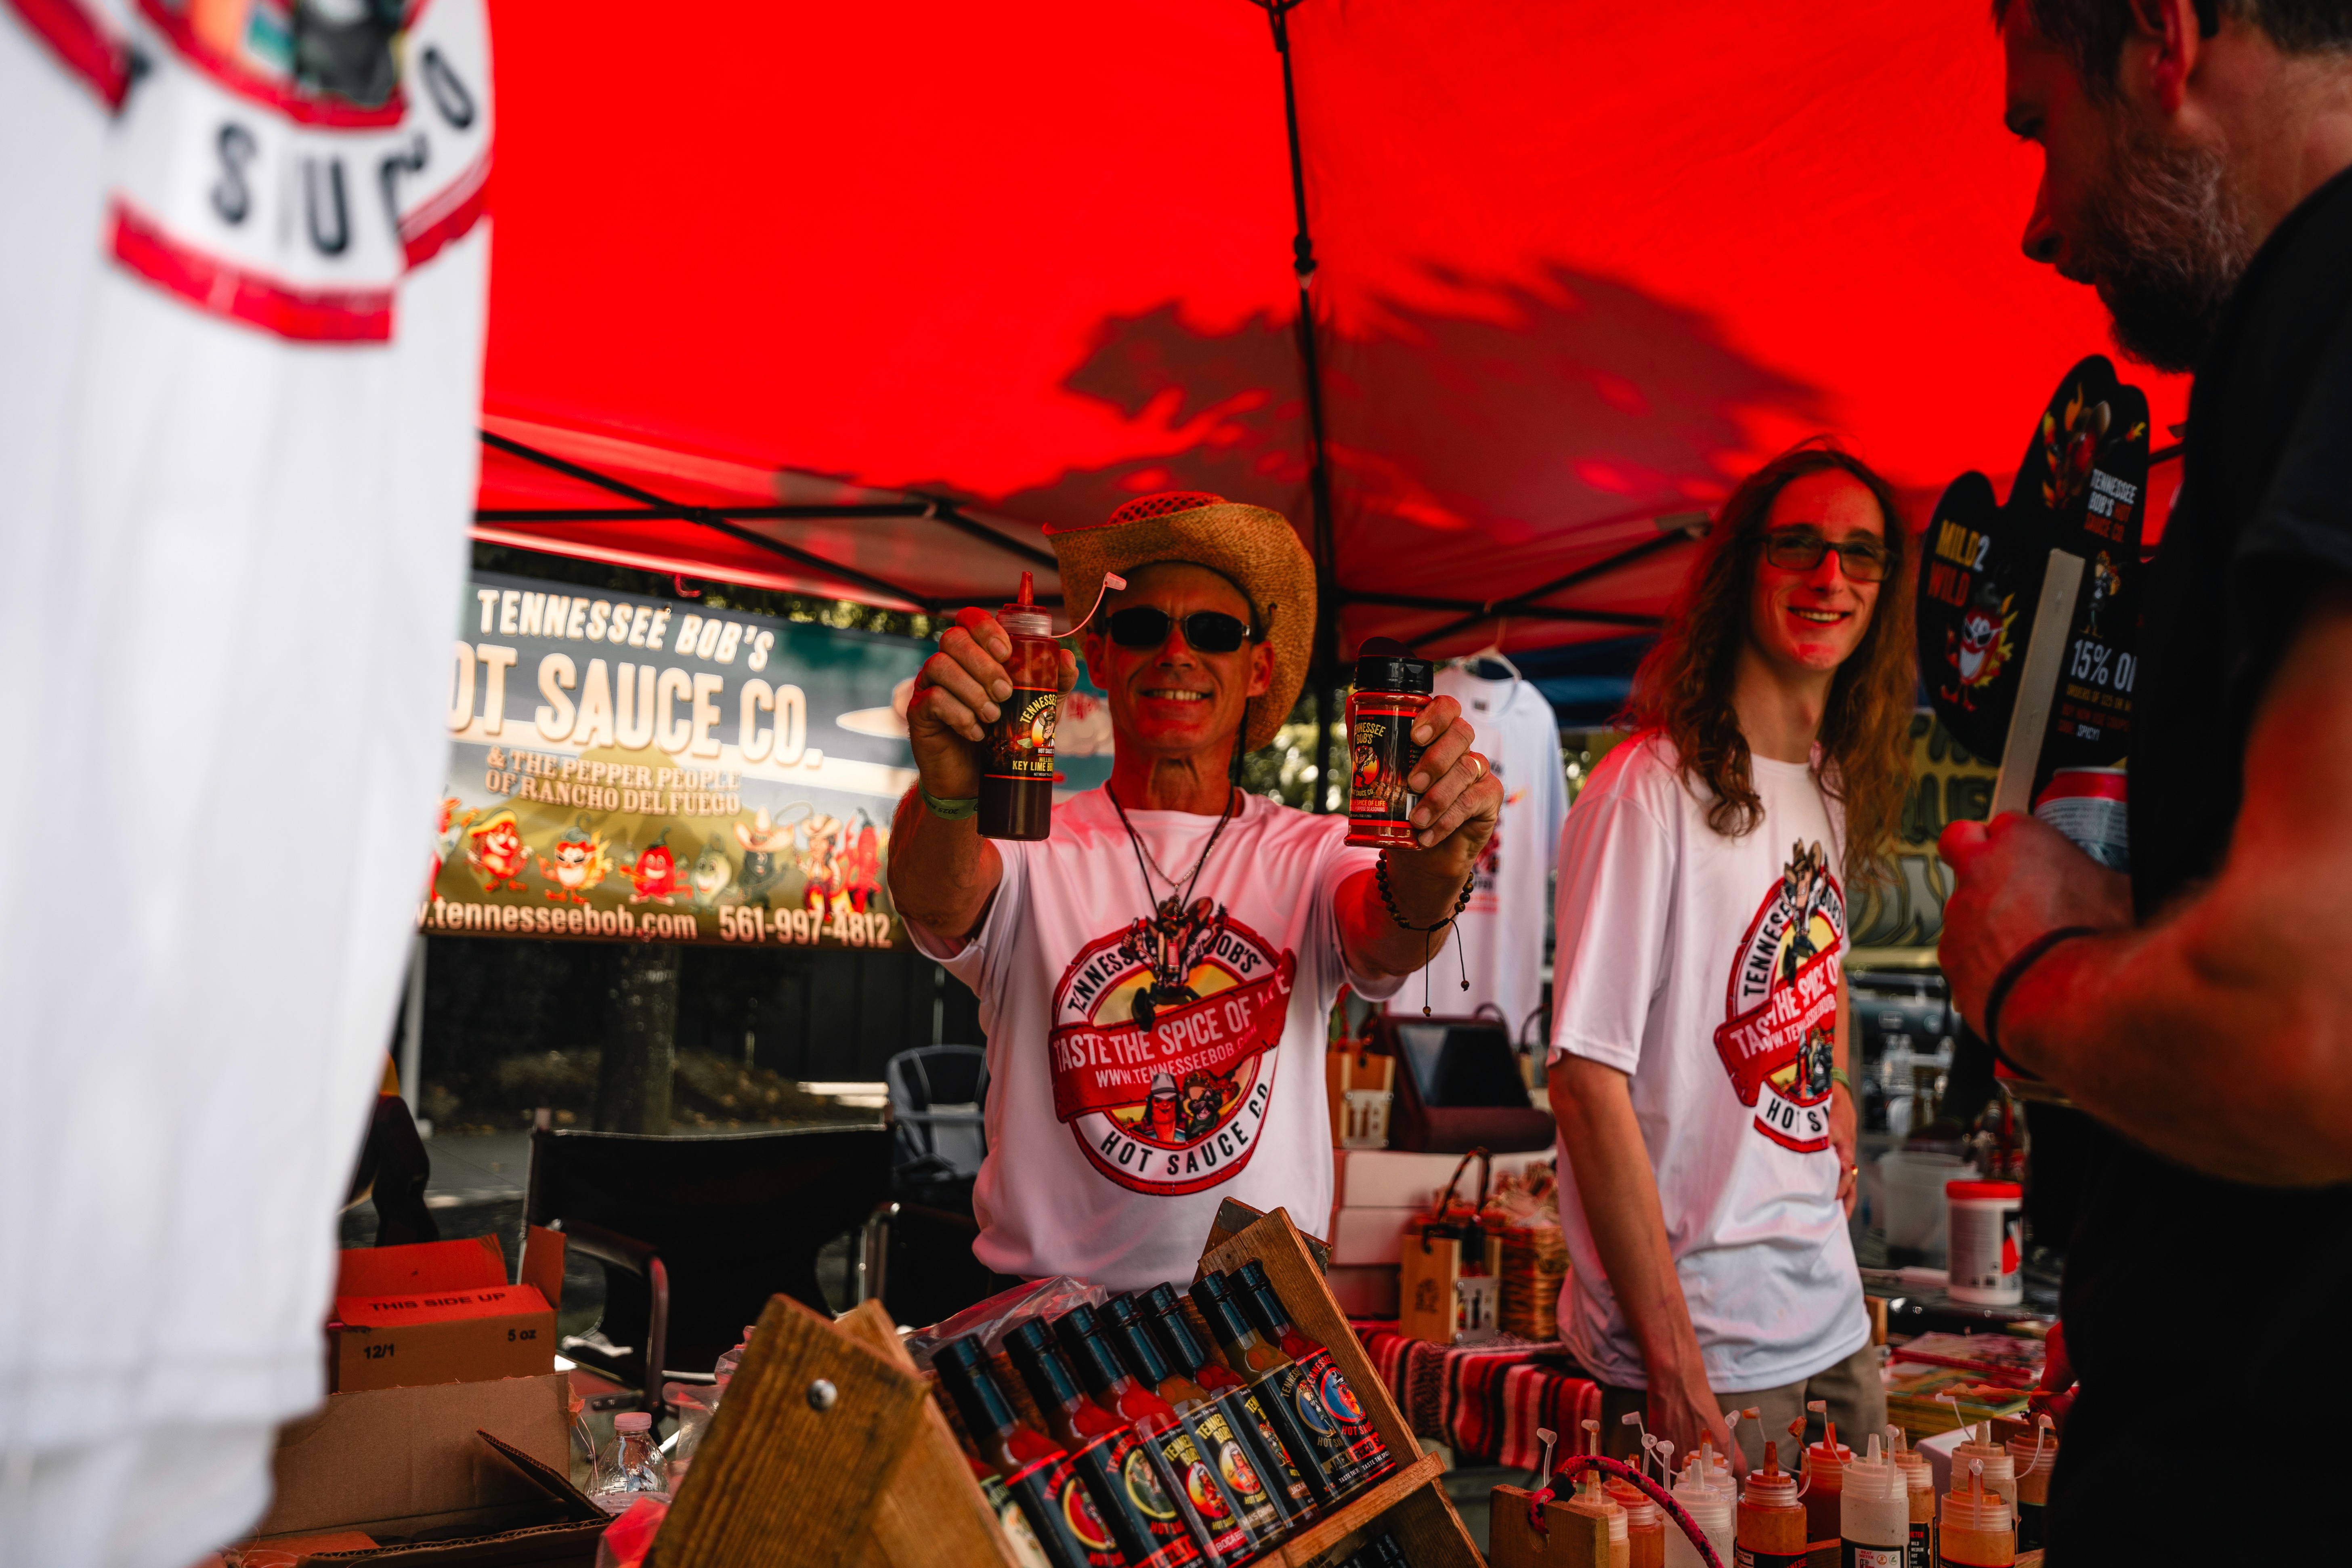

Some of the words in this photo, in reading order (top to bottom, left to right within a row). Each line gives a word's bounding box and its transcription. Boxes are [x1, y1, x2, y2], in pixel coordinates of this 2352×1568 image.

[2090, 468, 2138, 505] TENNESSEE
[2088, 491, 2115, 517] BOB'S
[1935, 518, 1980, 566] MILD
[1973, 534, 1990, 572] 2
[1927, 560, 1971, 607] WILD
[477, 590, 672, 650] TENNESSEE
[675, 613, 774, 672] BOB'S
[2070, 639, 2112, 685] 15%
[447, 640, 518, 735] OT
[535, 653, 724, 758] SAUCE
[740, 678, 824, 769] CO.
[1355, 722, 1386, 737] ENNESSEE
[1357, 733, 1373, 745] BOB'S
[486, 745, 506, 770] &
[509, 748, 558, 779] THE
[562, 759, 653, 789] PEPPER
[657, 766, 742, 791] PEOPLE
[1012, 760, 1028, 770] KEY
[1030, 762, 1046, 771] LIME
[485, 769, 517, 795] OF
[520, 775, 620, 812] RANCHO
[622, 788, 669, 815] DEL
[669, 791, 742, 816] FUEGO
[719, 905, 893, 949] 561-997-4812
[1217, 935, 1259, 973] OB'S
[1053, 1032, 1112, 1073] TASTE
[1110, 1029, 1155, 1064] THE
[1157, 1006, 1223, 1055] SPICE
[1224, 995, 1251, 1033] OF
[1099, 1130, 1153, 1172] HOT
[1167, 1121, 1248, 1175] SAUCE
[368, 1300, 418, 1311] THIS
[423, 1295, 472, 1308] SIDE
[478, 1292, 506, 1304] UP
[508, 1329, 516, 1342] 5
[363, 1343, 394, 1360] 12/1
[1341, 1425, 1357, 1435] HOT
[1318, 1436, 1332, 1448] HOT
[1362, 1460, 1375, 1471] TASTE
[1339, 1473, 1351, 1483] TASTE
[1244, 1495, 1255, 1505] HOT
[1212, 1520, 1223, 1530] HOT
[1215, 1533, 1236, 1551] BOCA
